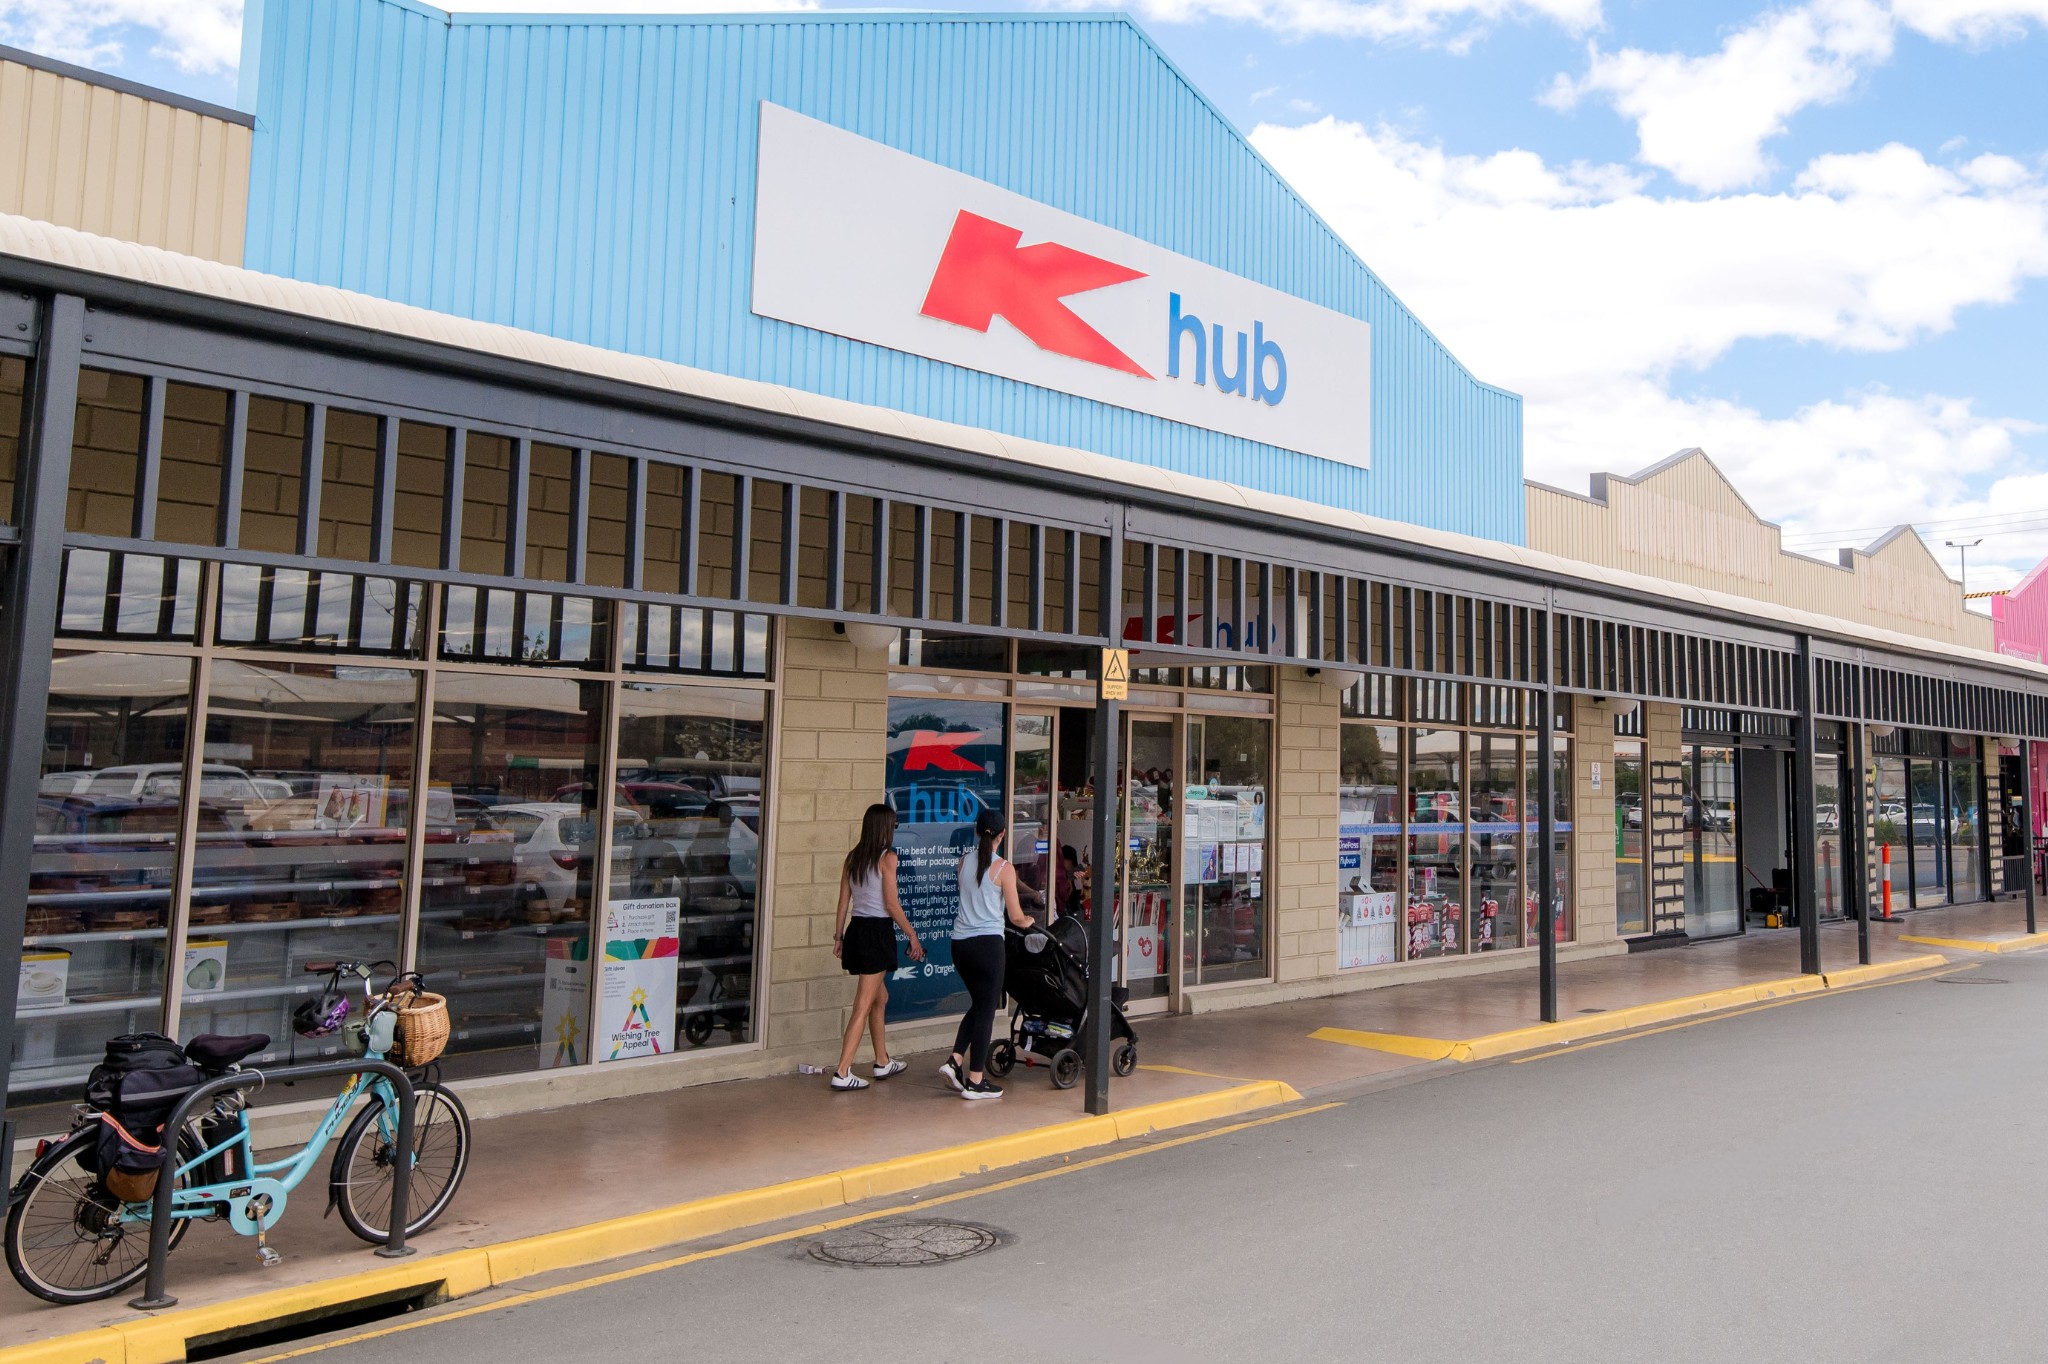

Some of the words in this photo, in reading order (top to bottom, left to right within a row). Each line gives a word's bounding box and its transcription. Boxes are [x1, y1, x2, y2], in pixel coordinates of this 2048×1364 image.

[1167, 292, 1287, 406] hub
[909, 783, 978, 824] hub
[896, 846, 910, 855] The
[911, 846, 926, 854] best
[928, 845, 936, 854] of
[938, 845, 962, 854] Kmart,
[962, 844, 975, 855] just
[902, 858, 928, 866] smaller
[898, 884, 912, 894] ou'll
[914, 884, 928, 893] find
[930, 884, 940, 892] the
[942, 882, 956, 892] best
[623, 903, 635, 911] Gift
[636, 902, 664, 910] donation
[912, 895, 948, 907] everything
[912, 908, 934, 918] Target
[935, 906, 948, 915] and
[932, 918, 952, 927] online
[918, 932, 927, 941] up
[928, 928, 944, 940] right
[934, 964, 955, 976] Target
[612, 1032, 642, 1042] Wishing
[644, 1030, 660, 1038] Tree
[622, 1038, 649, 1050] Appeal
